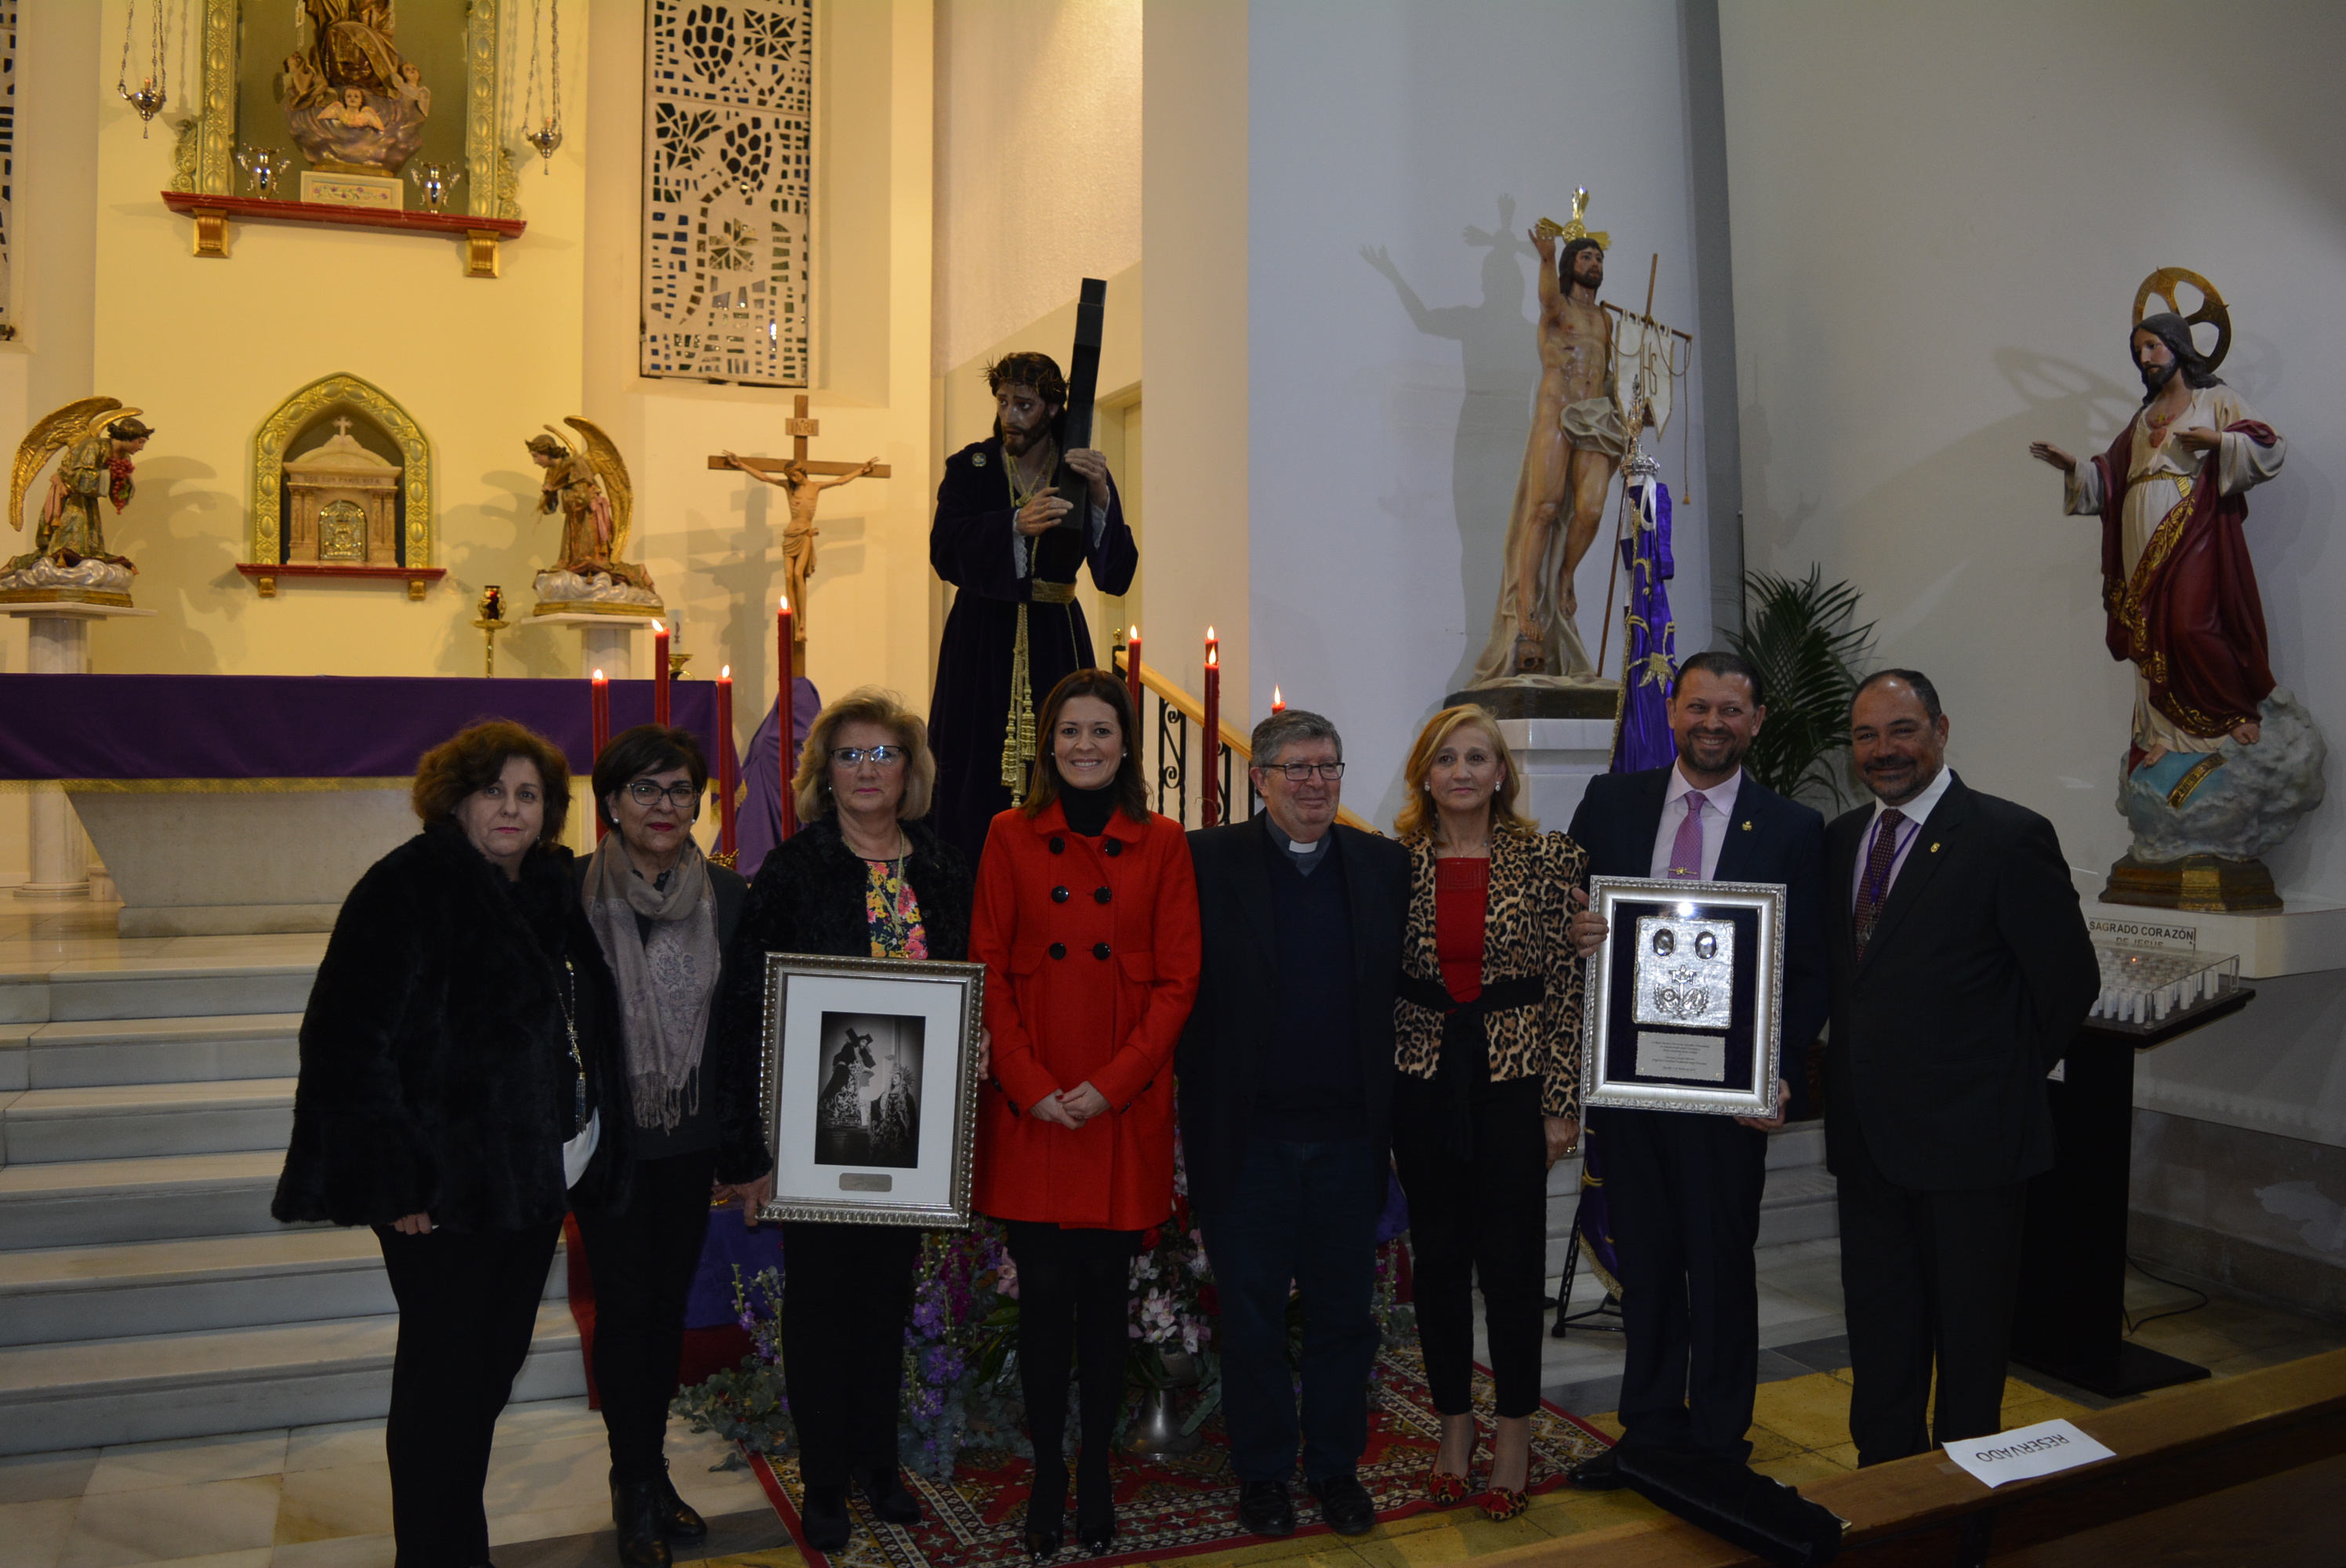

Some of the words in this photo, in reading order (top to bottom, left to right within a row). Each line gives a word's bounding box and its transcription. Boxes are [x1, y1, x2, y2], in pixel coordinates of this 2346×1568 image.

[790, 422, 814, 434] INRI
[2089, 920, 2138, 935] SAGRADO
[2141, 926, 2194, 941] CORAZÓN
[2115, 937, 2129, 946] DE
[1975, 1433, 2070, 1462] RESERVADO
